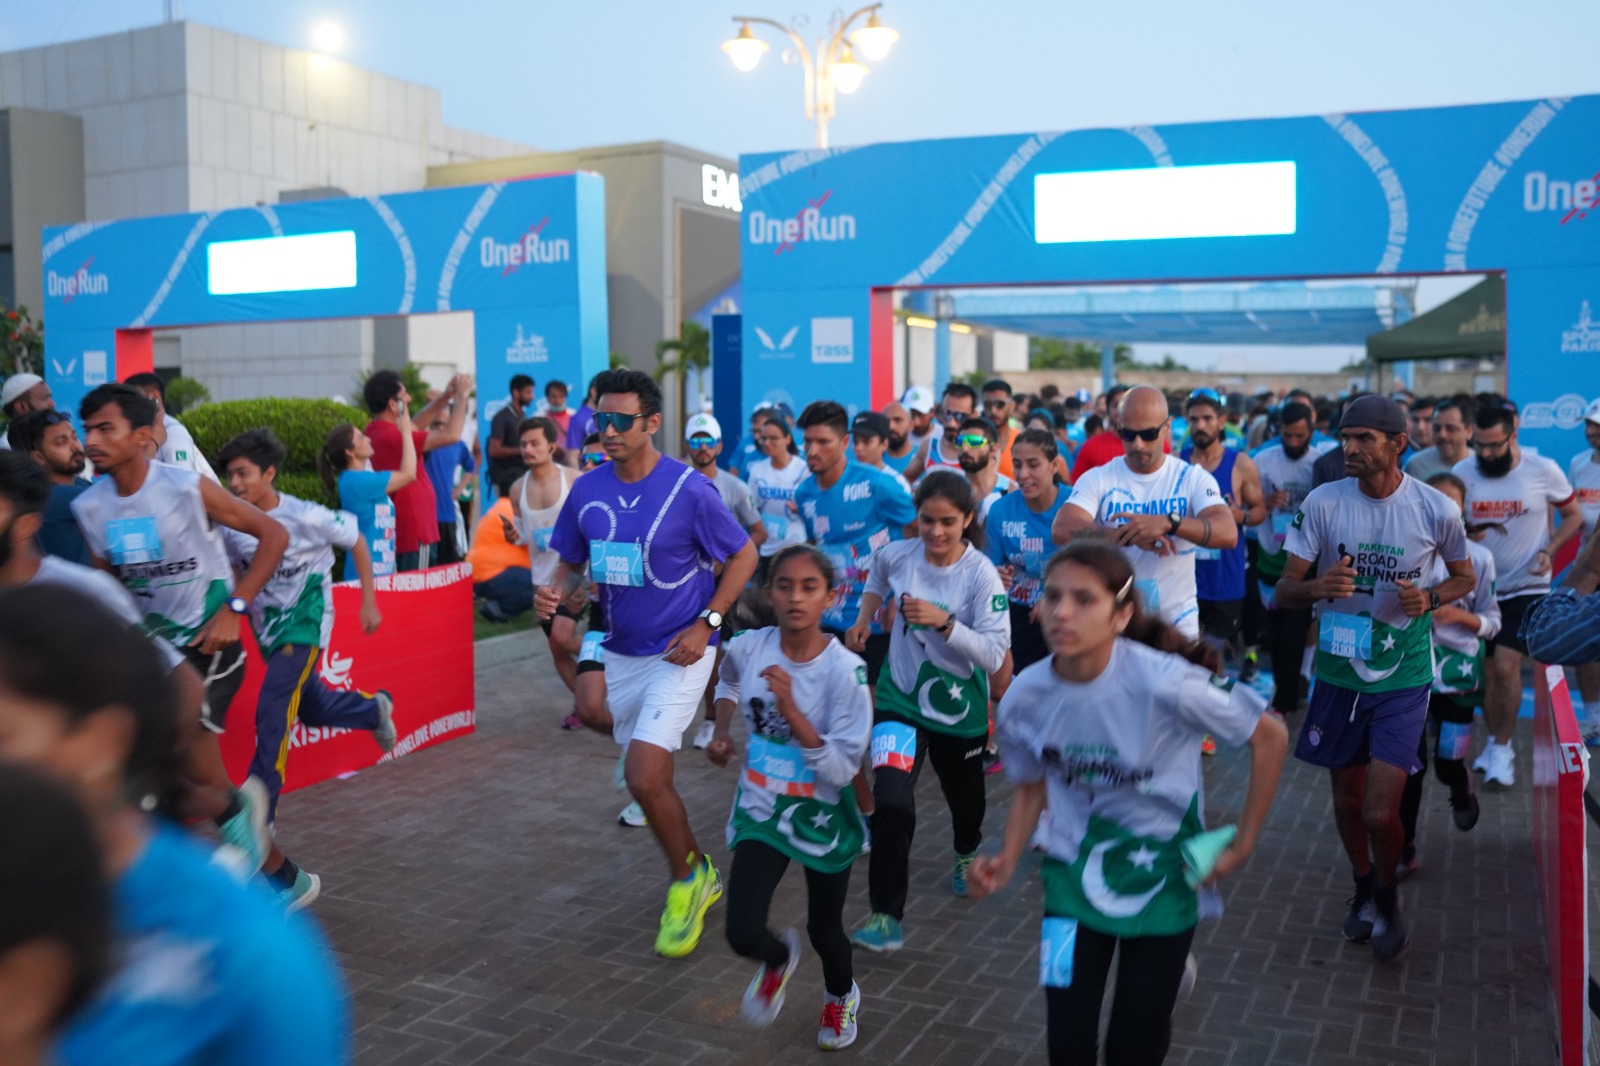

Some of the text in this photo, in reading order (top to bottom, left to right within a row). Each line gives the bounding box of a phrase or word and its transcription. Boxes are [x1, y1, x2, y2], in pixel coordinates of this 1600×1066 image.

[1445, 159, 1507, 252] #ONEFUTURE
[1494, 101, 1556, 167] #ONERUN
[1358, 543, 1406, 556] PAKISTAN
[1357, 553, 1398, 569] ROAD
[392, 572, 426, 592] #ONERUN
[425, 564, 461, 590] #ONELOVE
[1356, 566, 1422, 583] RUNNERS
[392, 709, 475, 760] #ONELOVE #ONEWORLD
